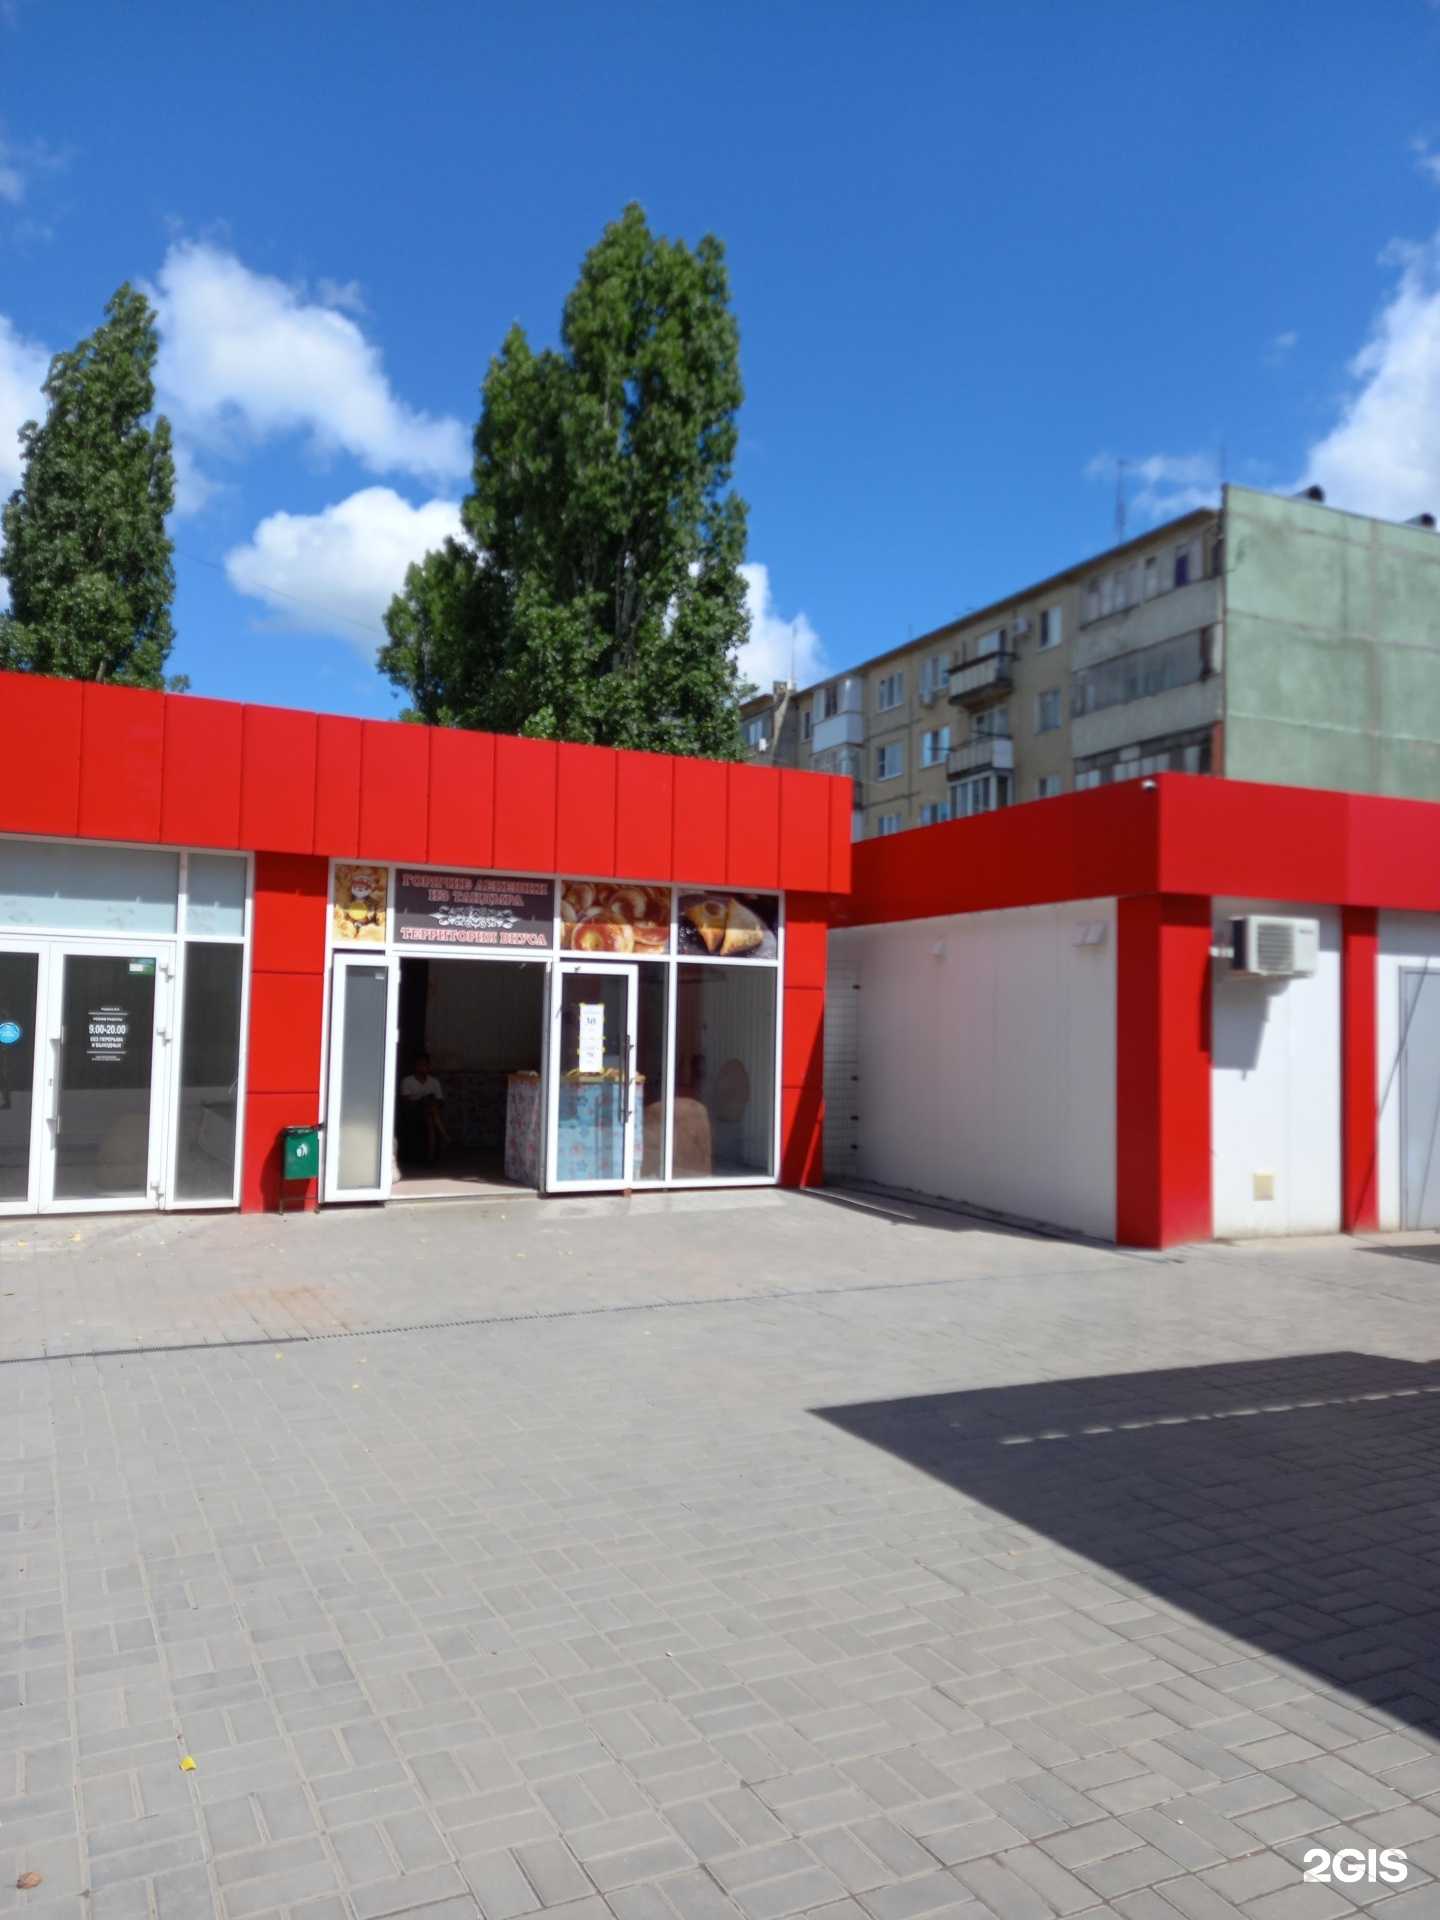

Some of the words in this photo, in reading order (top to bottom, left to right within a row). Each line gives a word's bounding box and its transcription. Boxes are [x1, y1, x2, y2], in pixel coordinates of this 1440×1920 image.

[427, 889, 450, 902] ИЗ
[400, 926, 498, 944] ТЕРРИТОРИЯ
[500, 931, 548, 946] ВКУСА
